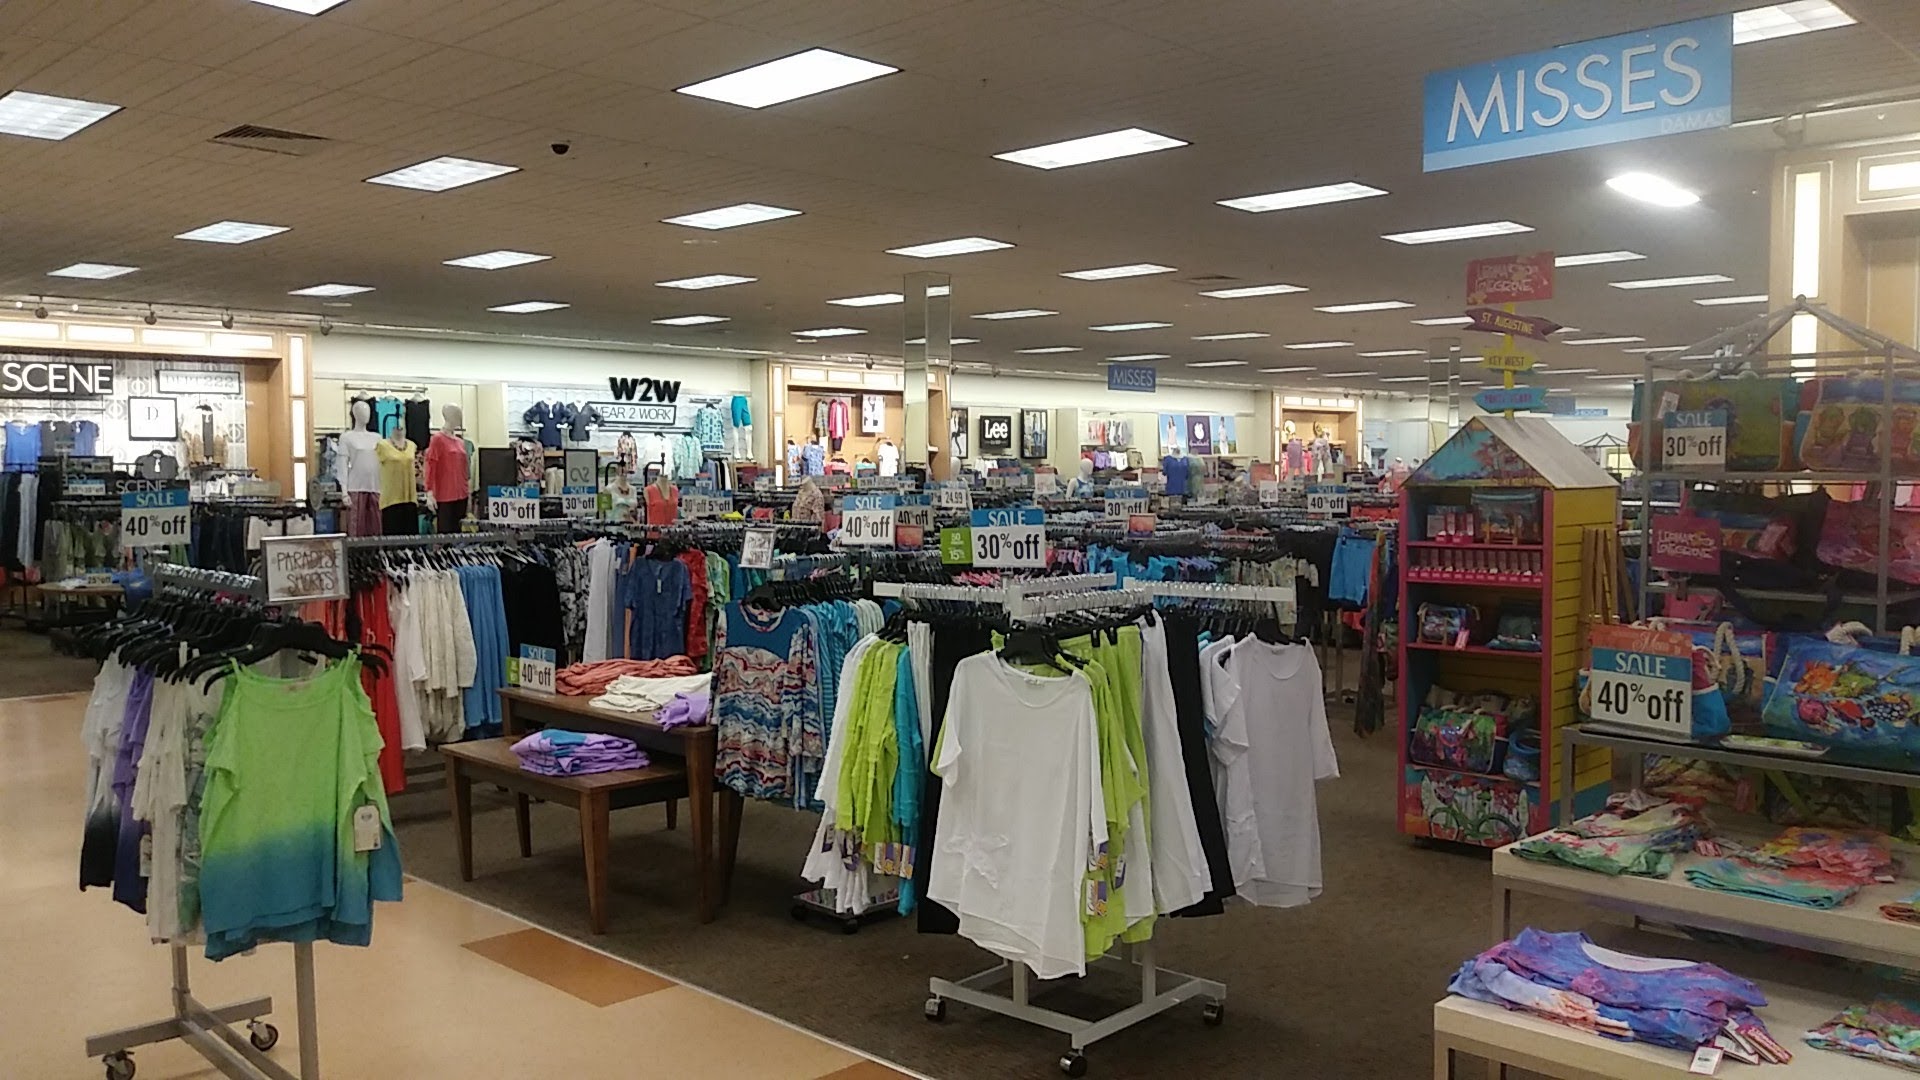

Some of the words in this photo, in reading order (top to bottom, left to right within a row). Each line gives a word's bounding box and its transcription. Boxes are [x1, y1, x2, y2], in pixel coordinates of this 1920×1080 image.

[1446, 37, 1702, 143] MISSES
[1660, 110, 1727, 134] DAMAS
[1495, 315, 1535, 335] AUGUSTINE
[1504, 356, 1525, 366] WEST
[1, 363, 112, 394] SCENE
[203, 375, 235, 388] 222
[1113, 369, 1153, 387] MISSES
[608, 376, 681, 403] W2W
[146, 406, 159, 421] D
[629, 407, 635, 419] 2
[639, 408, 672, 420] WORK
[1676, 412, 1712, 427] SALE
[985, 419, 1008, 439] Lee
[136, 492, 175, 507] SALE
[500, 488, 527, 498] SALE
[855, 497, 882, 510] SALE
[989, 510, 1026, 527] SALE
[276, 549, 342, 572] PARADISE
[287, 572, 335, 593] SHORES
[528, 647, 546, 661] SALE
[1615, 652, 1667, 678] SALE
